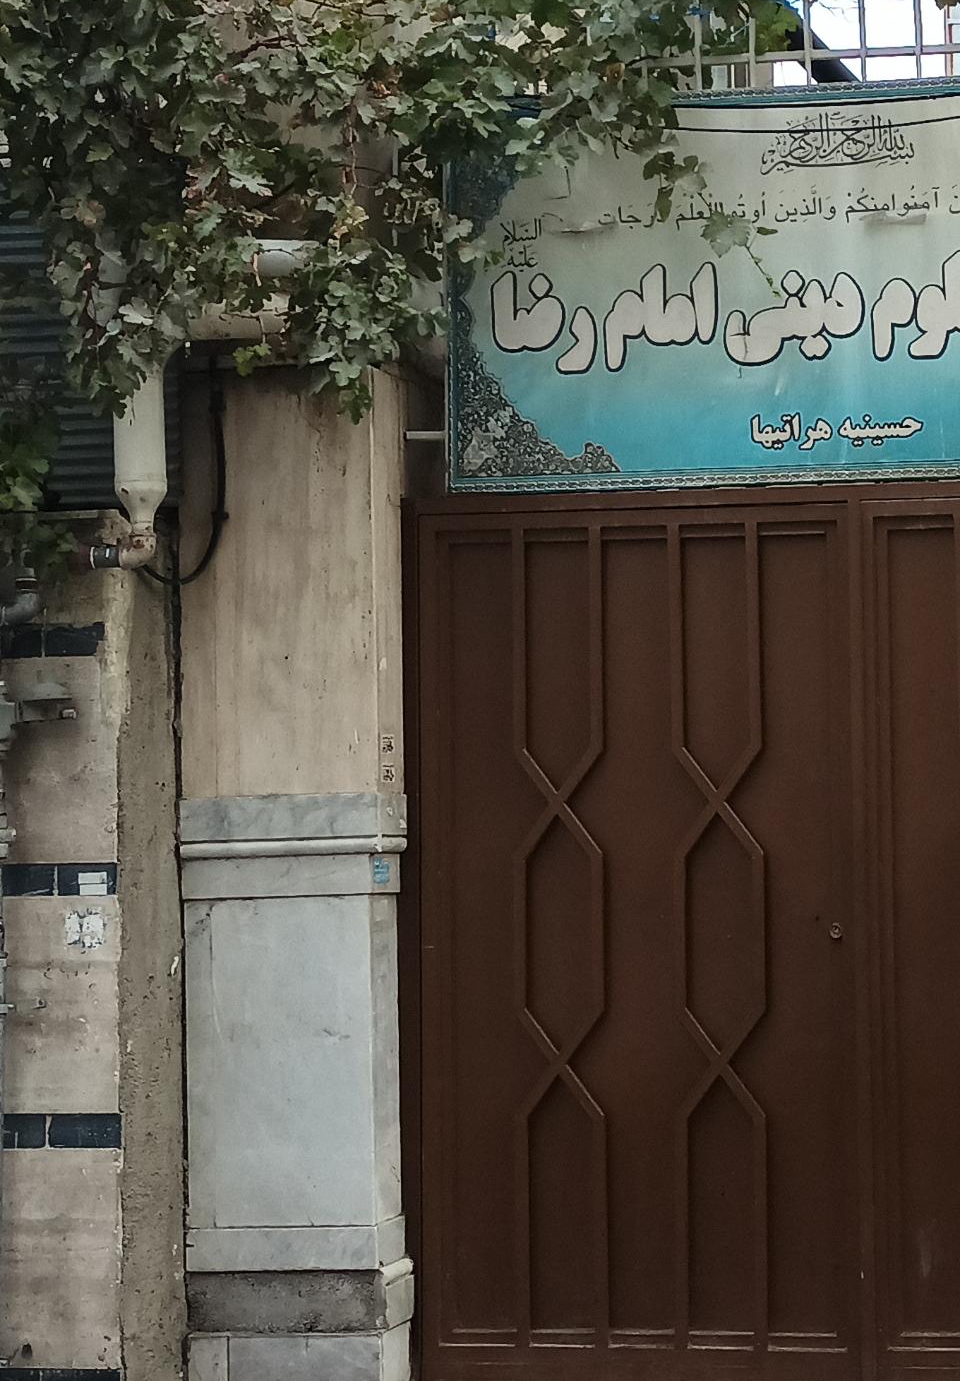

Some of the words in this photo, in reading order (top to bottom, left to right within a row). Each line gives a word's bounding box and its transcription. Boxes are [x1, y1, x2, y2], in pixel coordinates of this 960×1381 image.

[490, 270, 598, 375] رضا
[604, 260, 719, 373] امام
[723, 269, 866, 367] دینی
[750, 412, 833, 451] هراتیها
[837, 414, 924, 448] حسینیه
